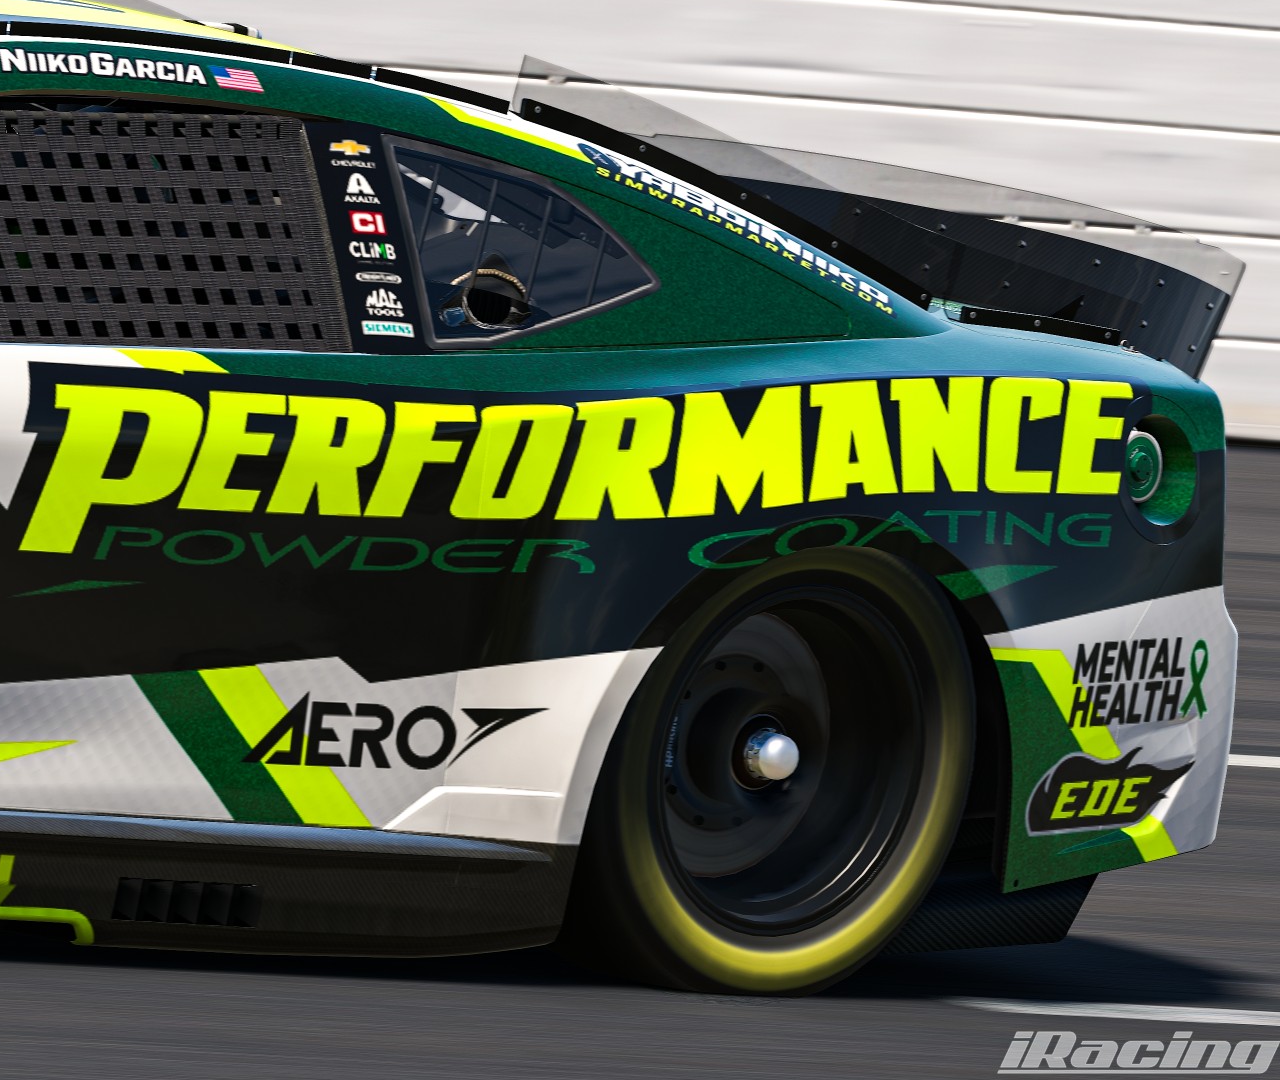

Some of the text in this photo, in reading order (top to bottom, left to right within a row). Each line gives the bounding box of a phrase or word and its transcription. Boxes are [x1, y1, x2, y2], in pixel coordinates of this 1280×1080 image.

[344, 195, 381, 205] AXALTA
[365, 322, 413, 335] SIEMENS
[366, 307, 405, 317] TOOLS
[18, 376, 1134, 553] PERFORMANCE
[93, 509, 1113, 575] POWDER COATING
[1072, 636, 1186, 684] MENTAL
[1069, 679, 1184, 728] HEALTH
[242, 689, 458, 769] AERO
[1050, 775, 1153, 821] EDE
